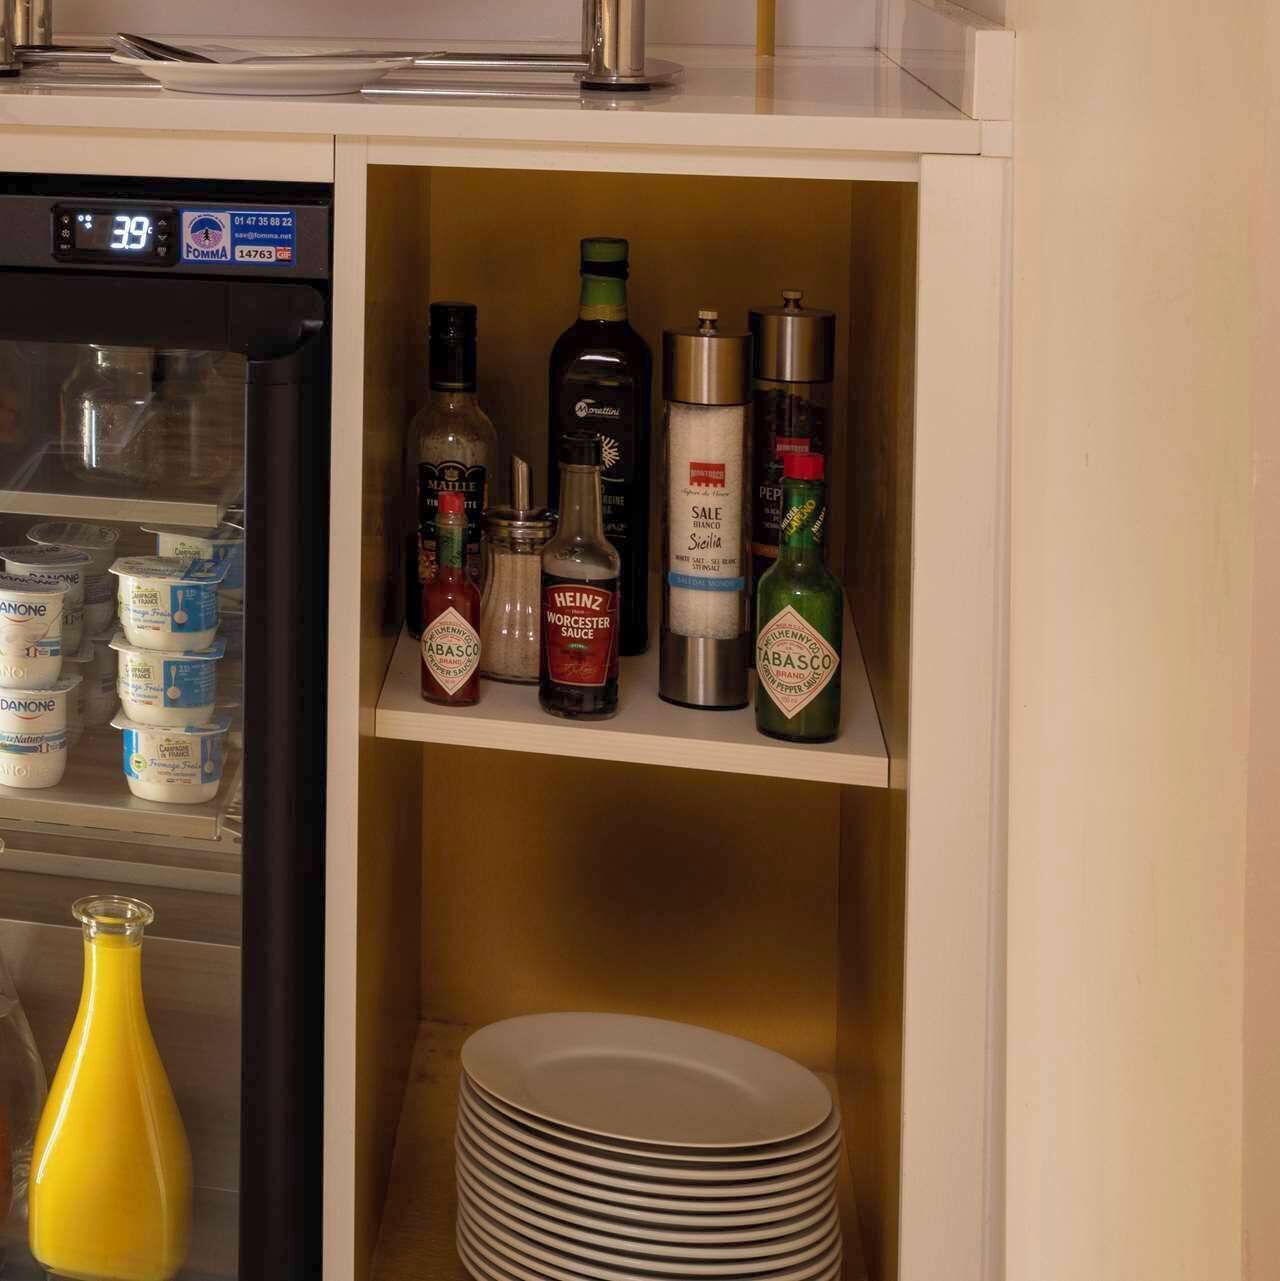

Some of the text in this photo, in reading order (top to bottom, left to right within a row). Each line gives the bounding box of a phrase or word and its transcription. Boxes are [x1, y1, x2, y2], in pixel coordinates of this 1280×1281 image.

[234, 216, 244, 225] 01
[246, 217, 256, 226] 47
[258, 217, 269, 226] 35
[282, 217, 293, 227] 22
[185, 242, 228, 260] FOMMA
[238, 249, 273, 260] 14763
[427, 480, 477, 492] MAILLE
[691, 505, 723, 521] SALE
[693, 521, 721, 530] BIANCO
[687, 531, 722, 551] Sicilia
[554, 592, 603, 611] HEINZ
[546, 610, 611, 629] WORCESTER
[561, 626, 594, 640] SAUCE
[423, 639, 479, 657] TABASCO
[440, 657, 462, 665] BRAND
[757, 646, 832, 671] TABASCO
[453, 657, 473, 677] SAUCE
[776, 669, 805, 680] BRAND
[776, 679, 805, 694] PEPPER
[804, 671, 822, 690] SAUCE
[0, 698, 56, 712] DANONE
